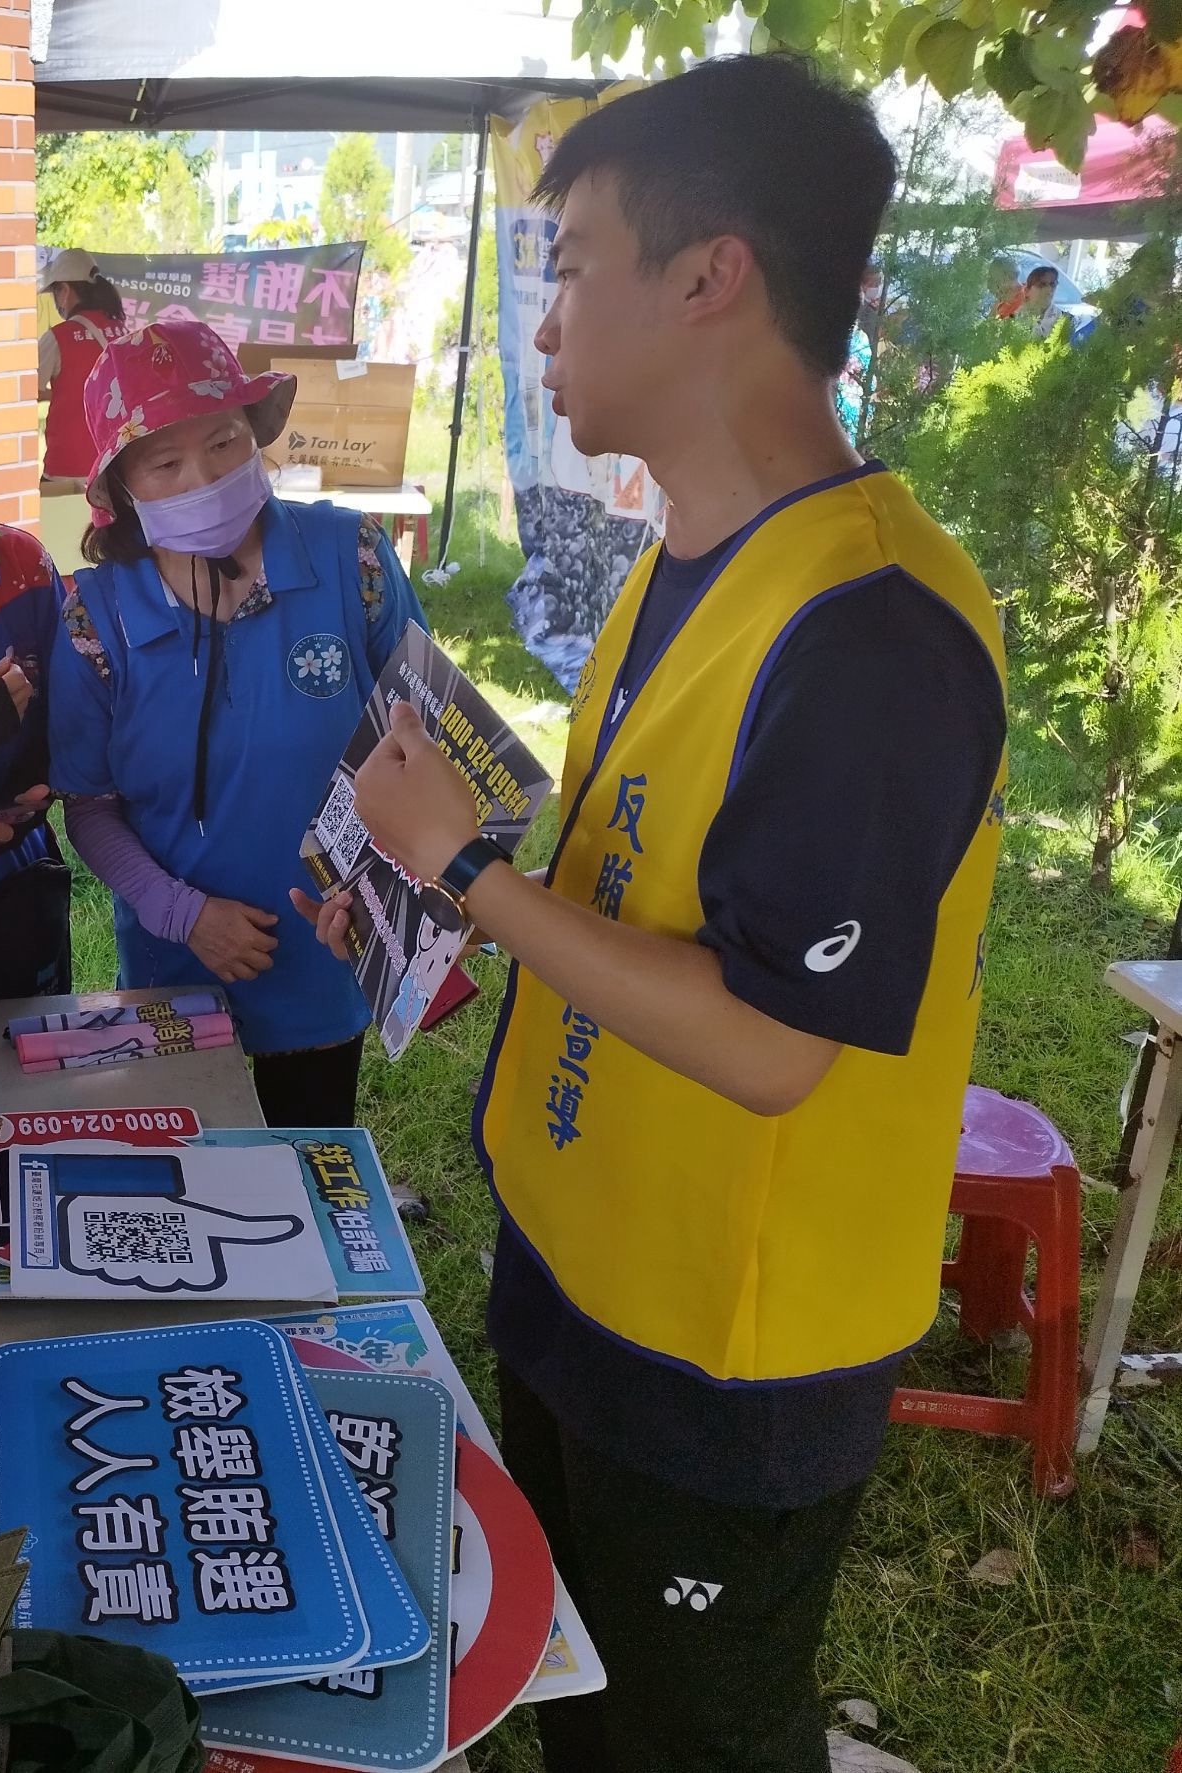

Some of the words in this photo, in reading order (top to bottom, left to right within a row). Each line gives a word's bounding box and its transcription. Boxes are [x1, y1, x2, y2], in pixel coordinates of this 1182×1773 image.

[310, 436, 338, 450] Tan
[439, 702, 531, 822] 0800-024-099#4
[18, 1111, 185, 1137] 0800-024-099
[311, 1143, 393, 1274] 找工作怕詐騙
[64, 1379, 175, 1623] 人人有責
[162, 1367, 291, 1612] 檢舉賄選
